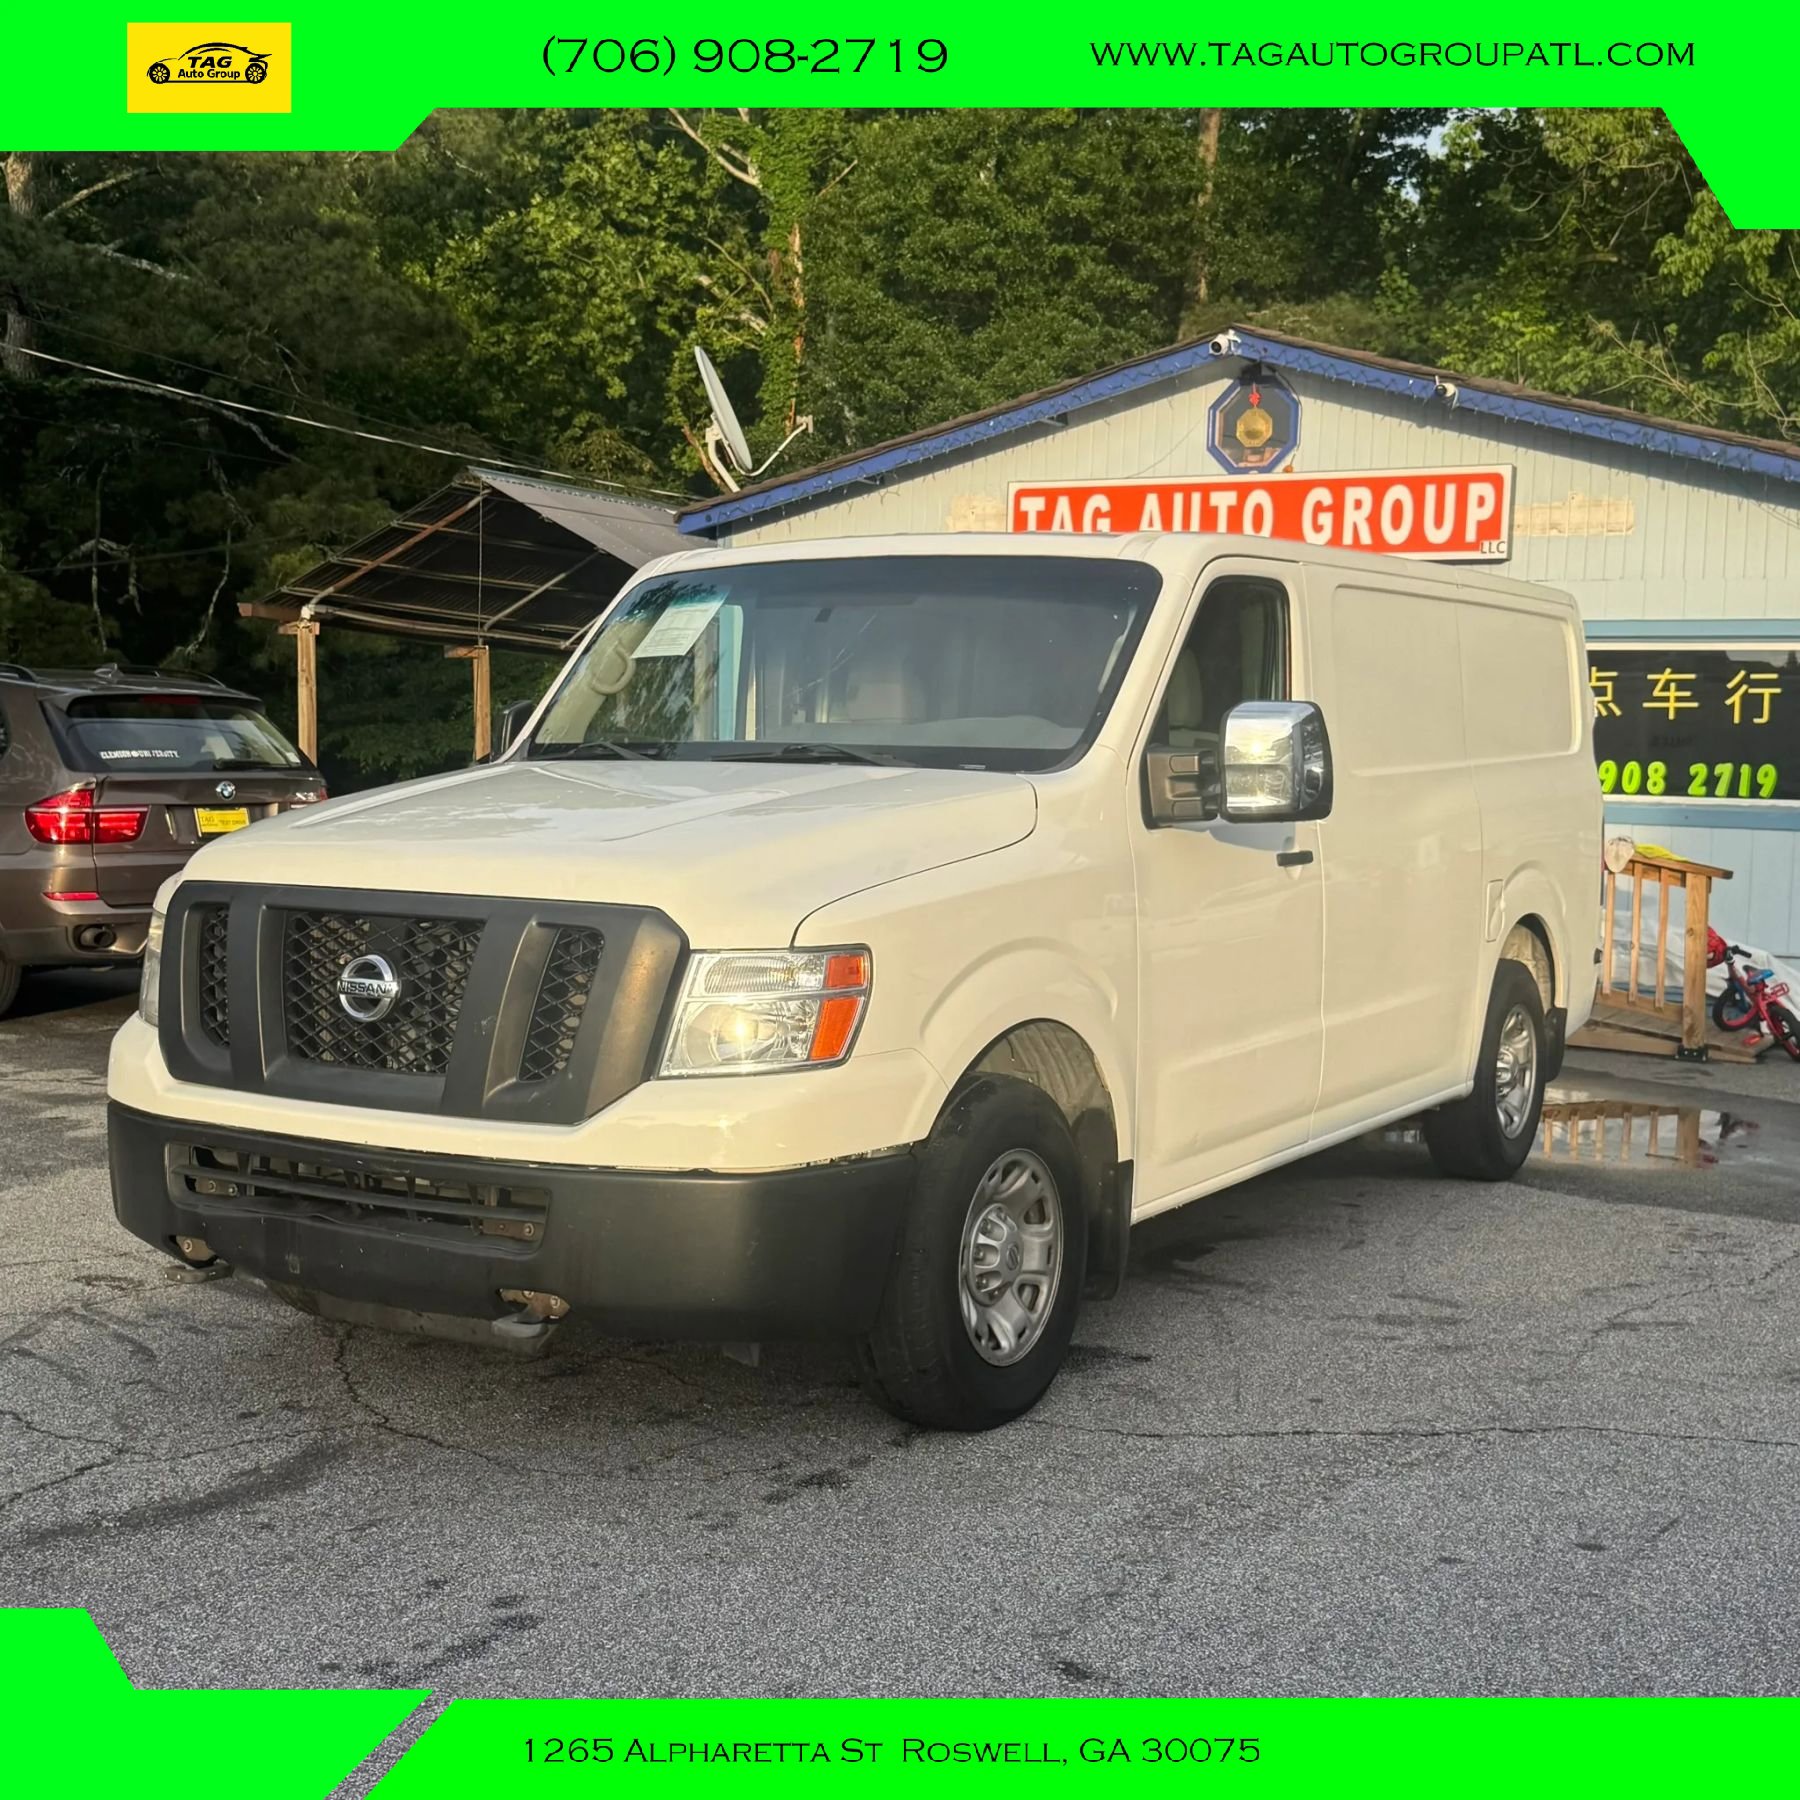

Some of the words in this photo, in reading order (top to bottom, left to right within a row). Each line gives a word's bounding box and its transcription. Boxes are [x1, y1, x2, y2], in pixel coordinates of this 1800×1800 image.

[1019, 494, 1111, 533] TAG
[1302, 482, 1496, 545] GROUP
[1480, 541, 1506, 554] LLC
[1598, 760, 1668, 796] 908
[1687, 763, 1778, 799] 2719
[338, 981, 387, 994] NISSAN
